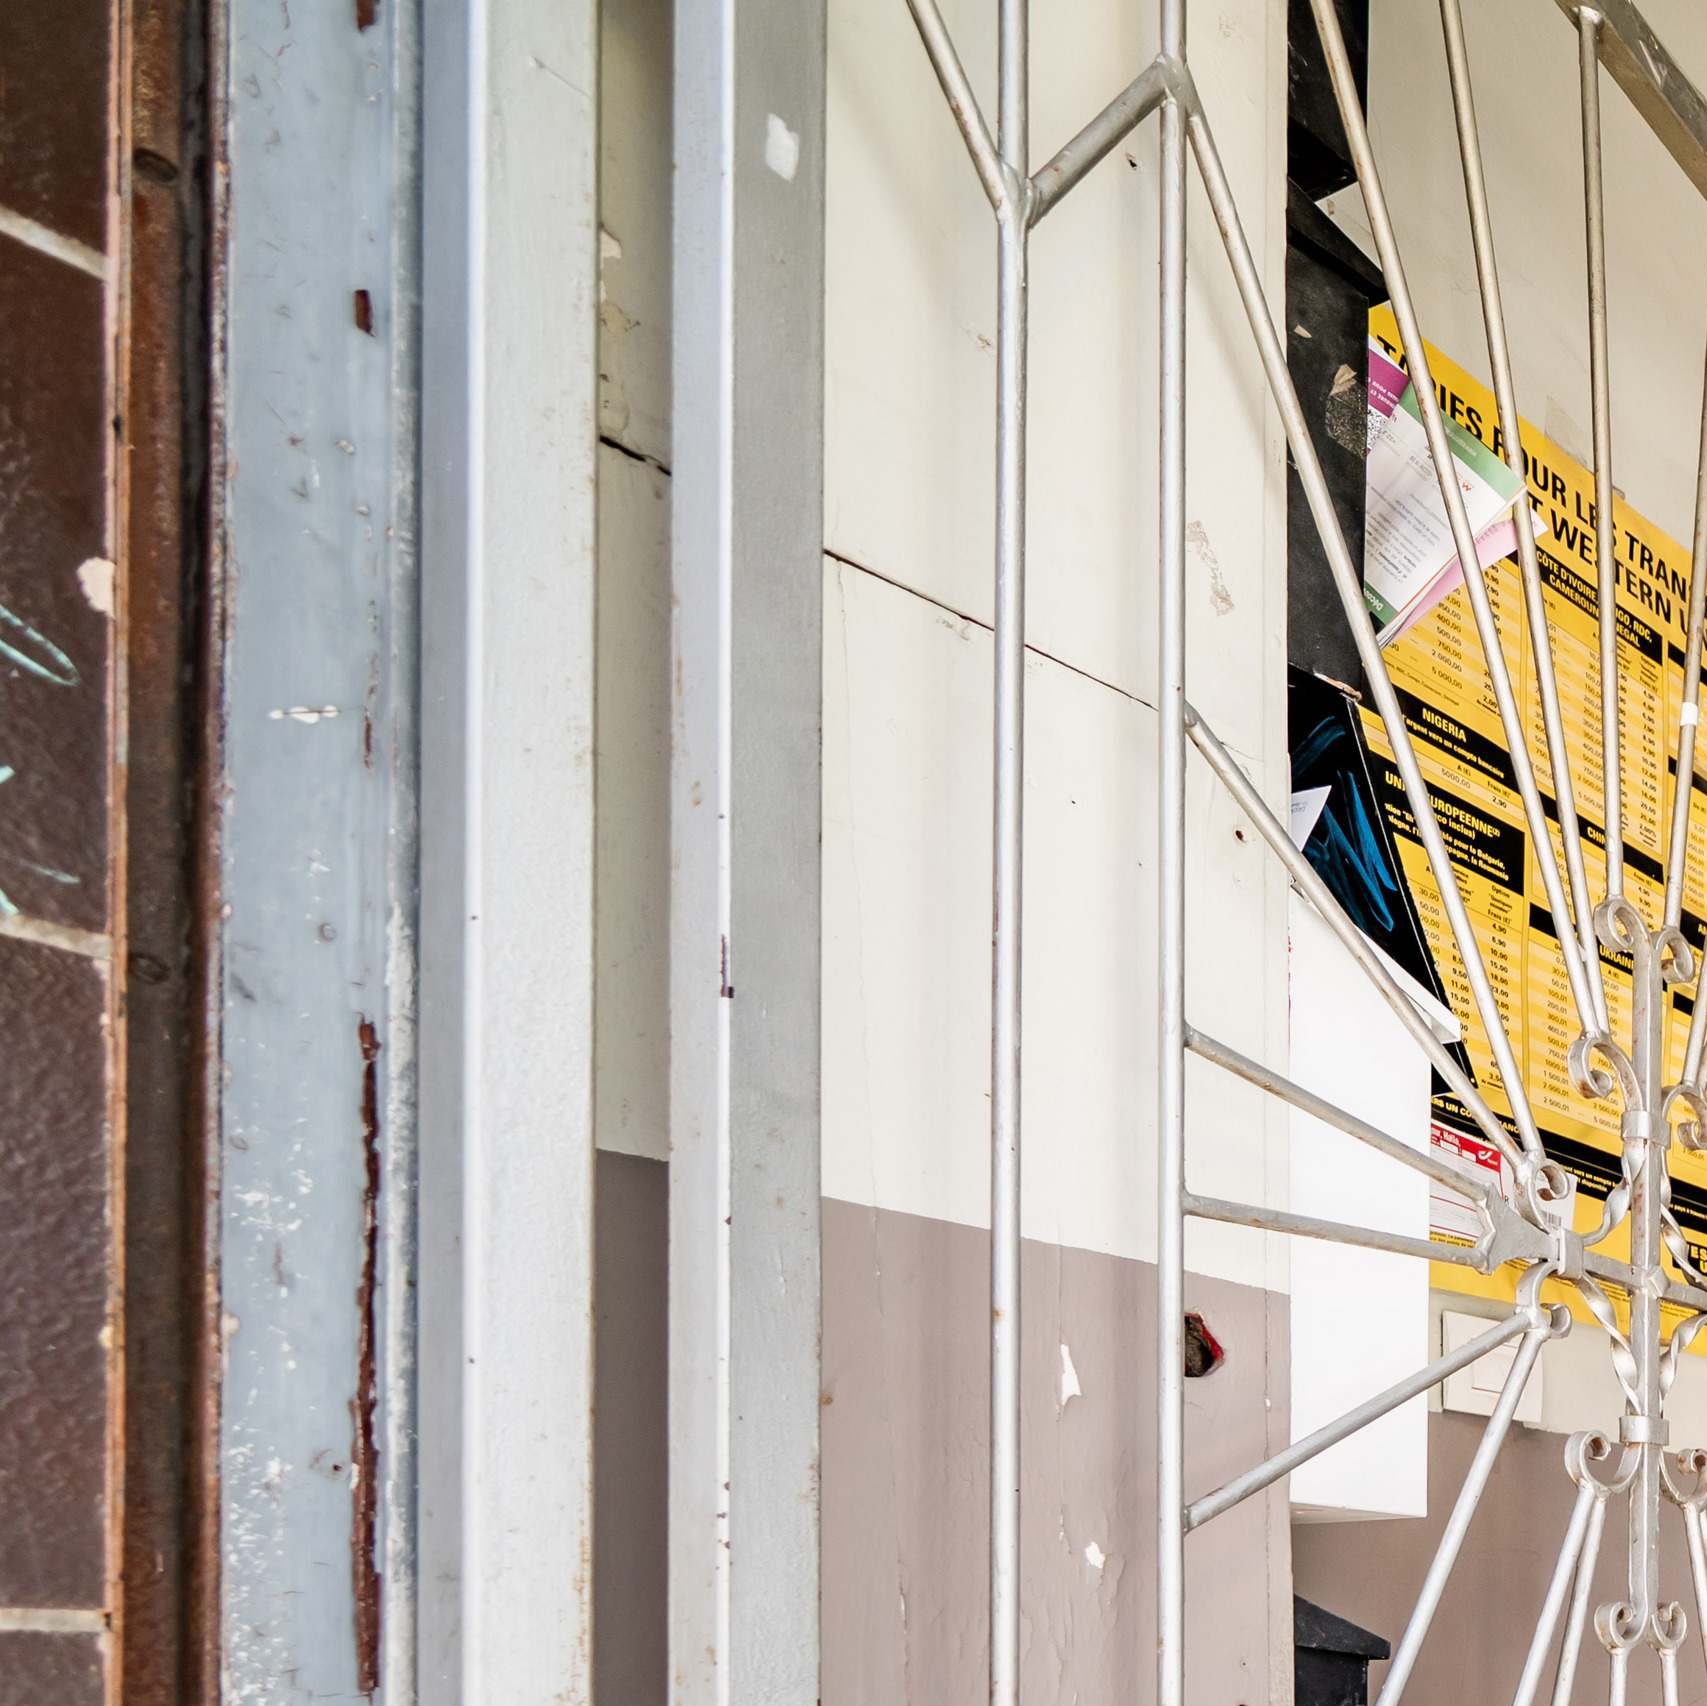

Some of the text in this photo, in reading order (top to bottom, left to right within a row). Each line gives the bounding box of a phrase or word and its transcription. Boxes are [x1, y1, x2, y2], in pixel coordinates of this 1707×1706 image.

[1536, 551, 1559, 575] CÔTE
[1436, 614, 1462, 633] 400,00
[1436, 627, 1462, 646] 500,00
[1438, 640, 1462, 659] 750,00
[1422, 708, 1467, 742] NIGERIA
[1429, 731, 1505, 779] vers un compte bancaire
[1442, 768, 1507, 809] 5000,00 2,90
[1454, 838, 1470, 851] pour
[1477, 849, 1506, 870] Bulgarie,
[1479, 859, 1509, 881] Roumanie
[1419, 887, 1439, 902] 30,00
[1420, 901, 1440, 916] 50,00
[1490, 948, 1508, 961] 10,00
[1490, 960, 1508, 973] 15,00
[1451, 980, 1469, 993] 11,00
[1450, 992, 1470, 1005] 15,00
